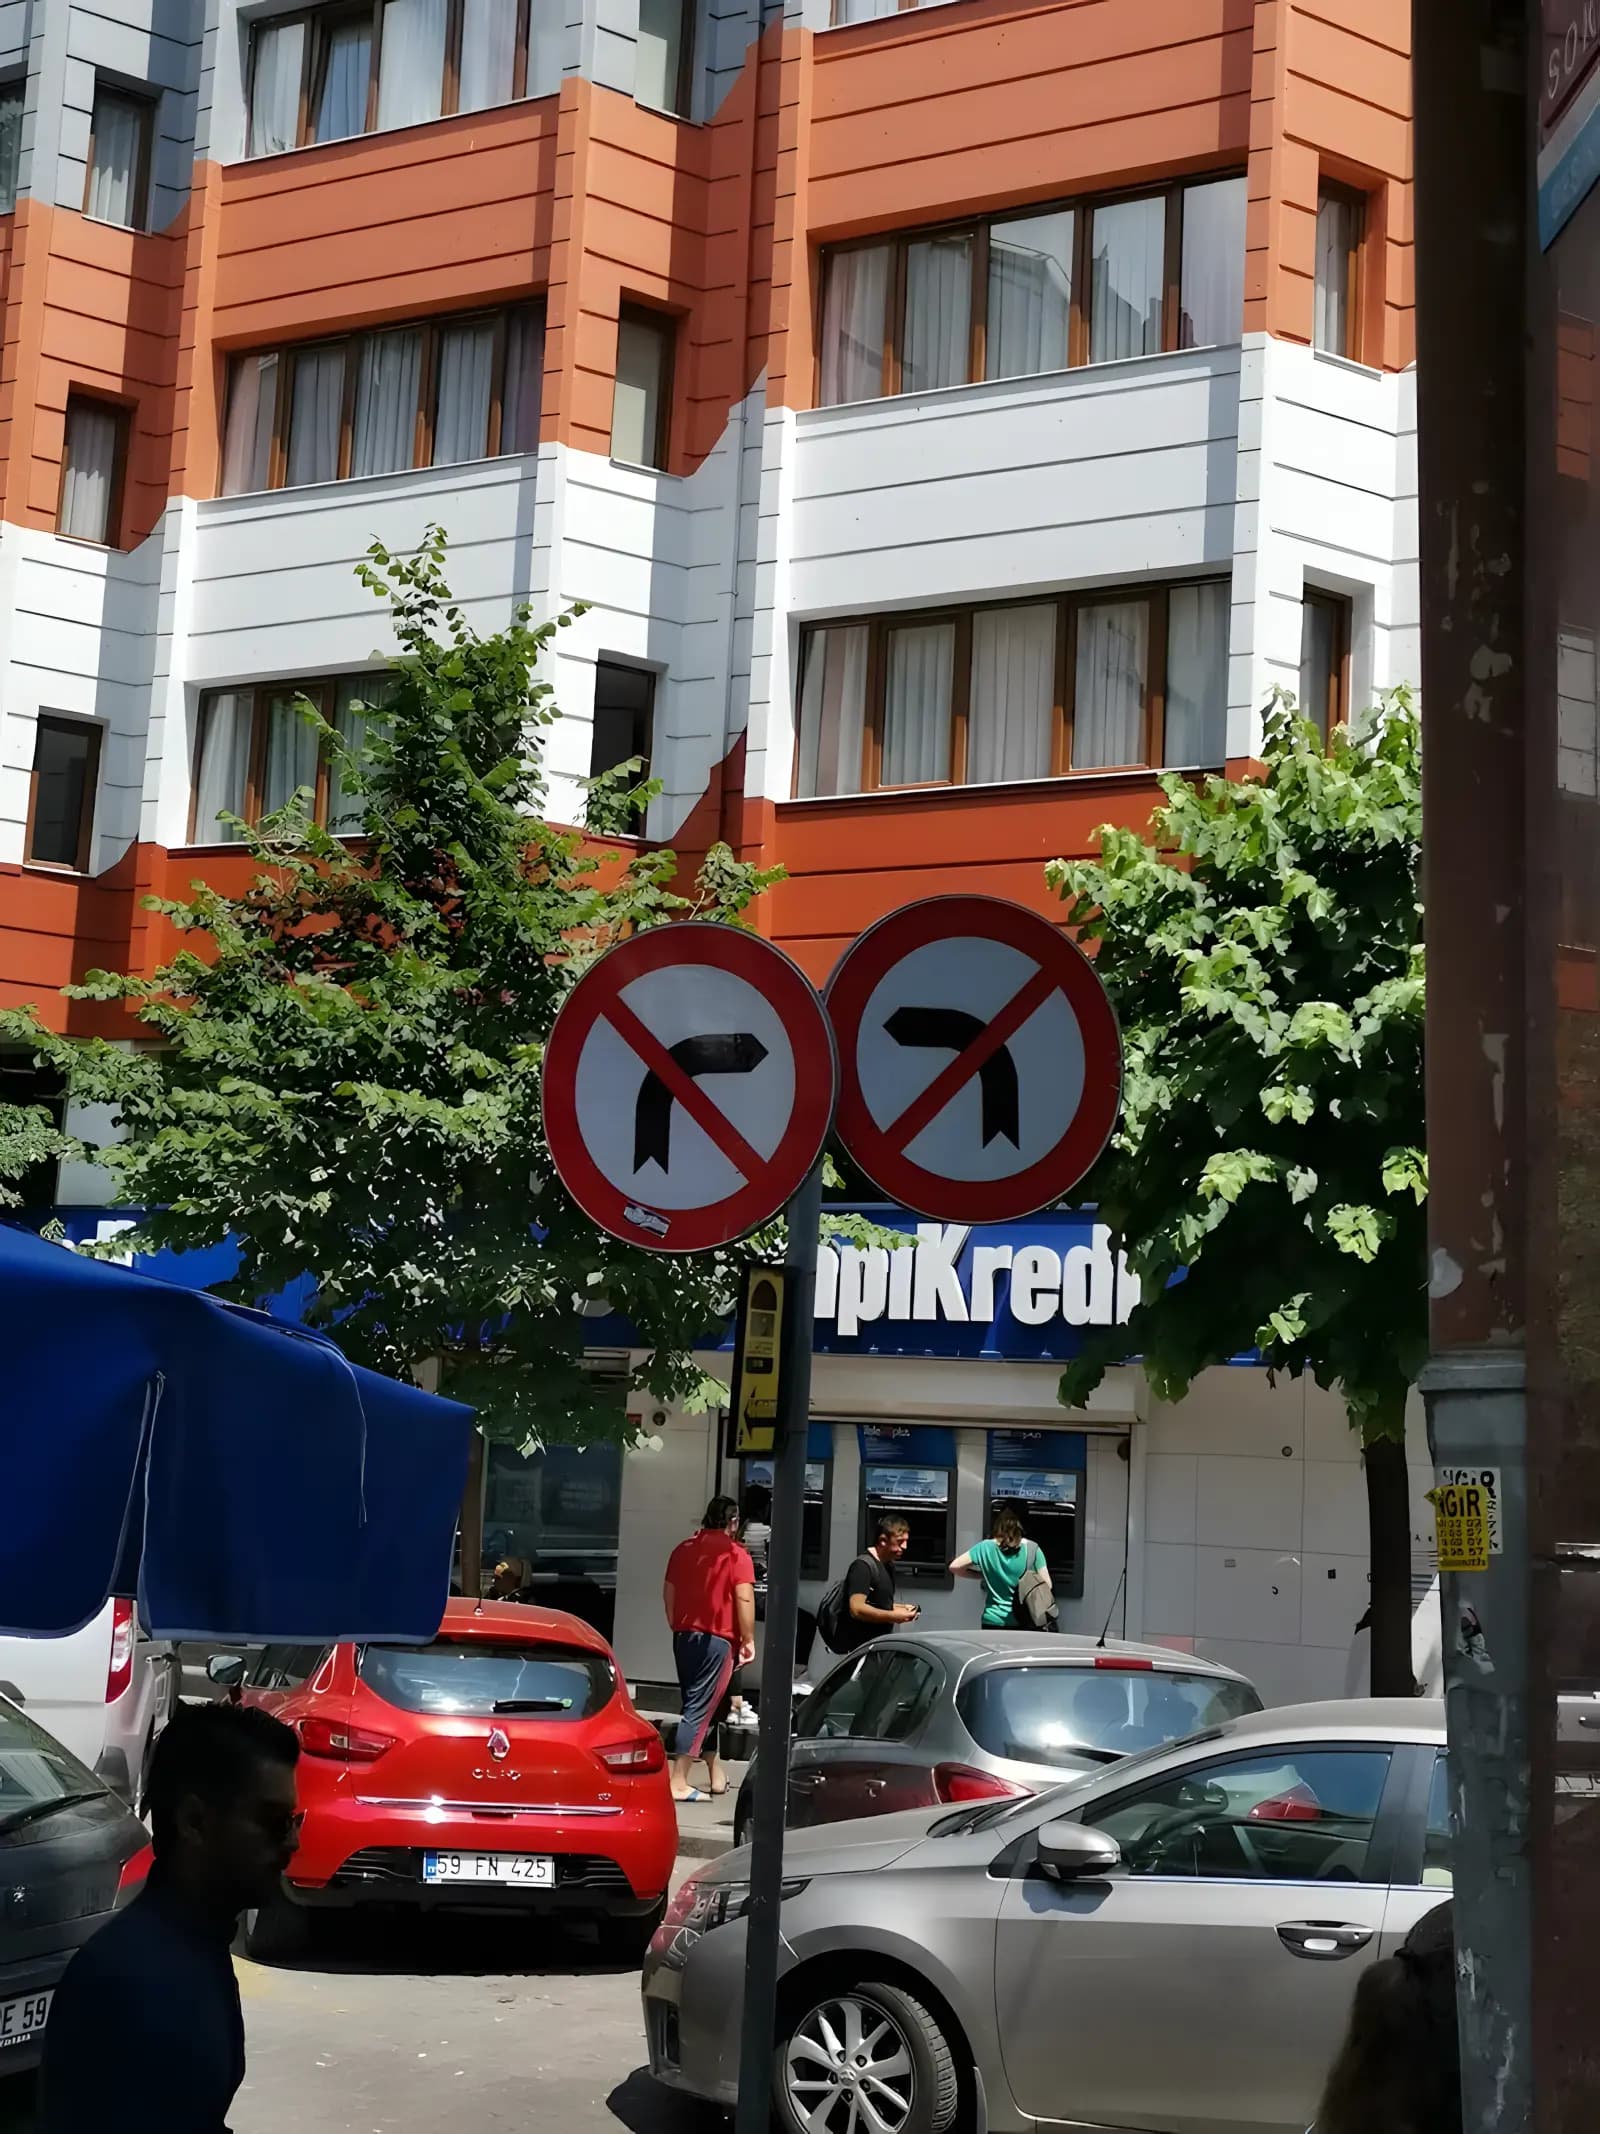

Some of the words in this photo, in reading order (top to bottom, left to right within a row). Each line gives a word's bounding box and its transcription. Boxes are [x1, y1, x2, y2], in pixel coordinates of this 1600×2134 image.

[472, 1767, 521, 1781] CLIO
[437, 1855, 461, 1875] 59
[476, 1856, 498, 1876] FN
[511, 1858, 547, 1878] 425
[23, 1997, 47, 2029] 59
